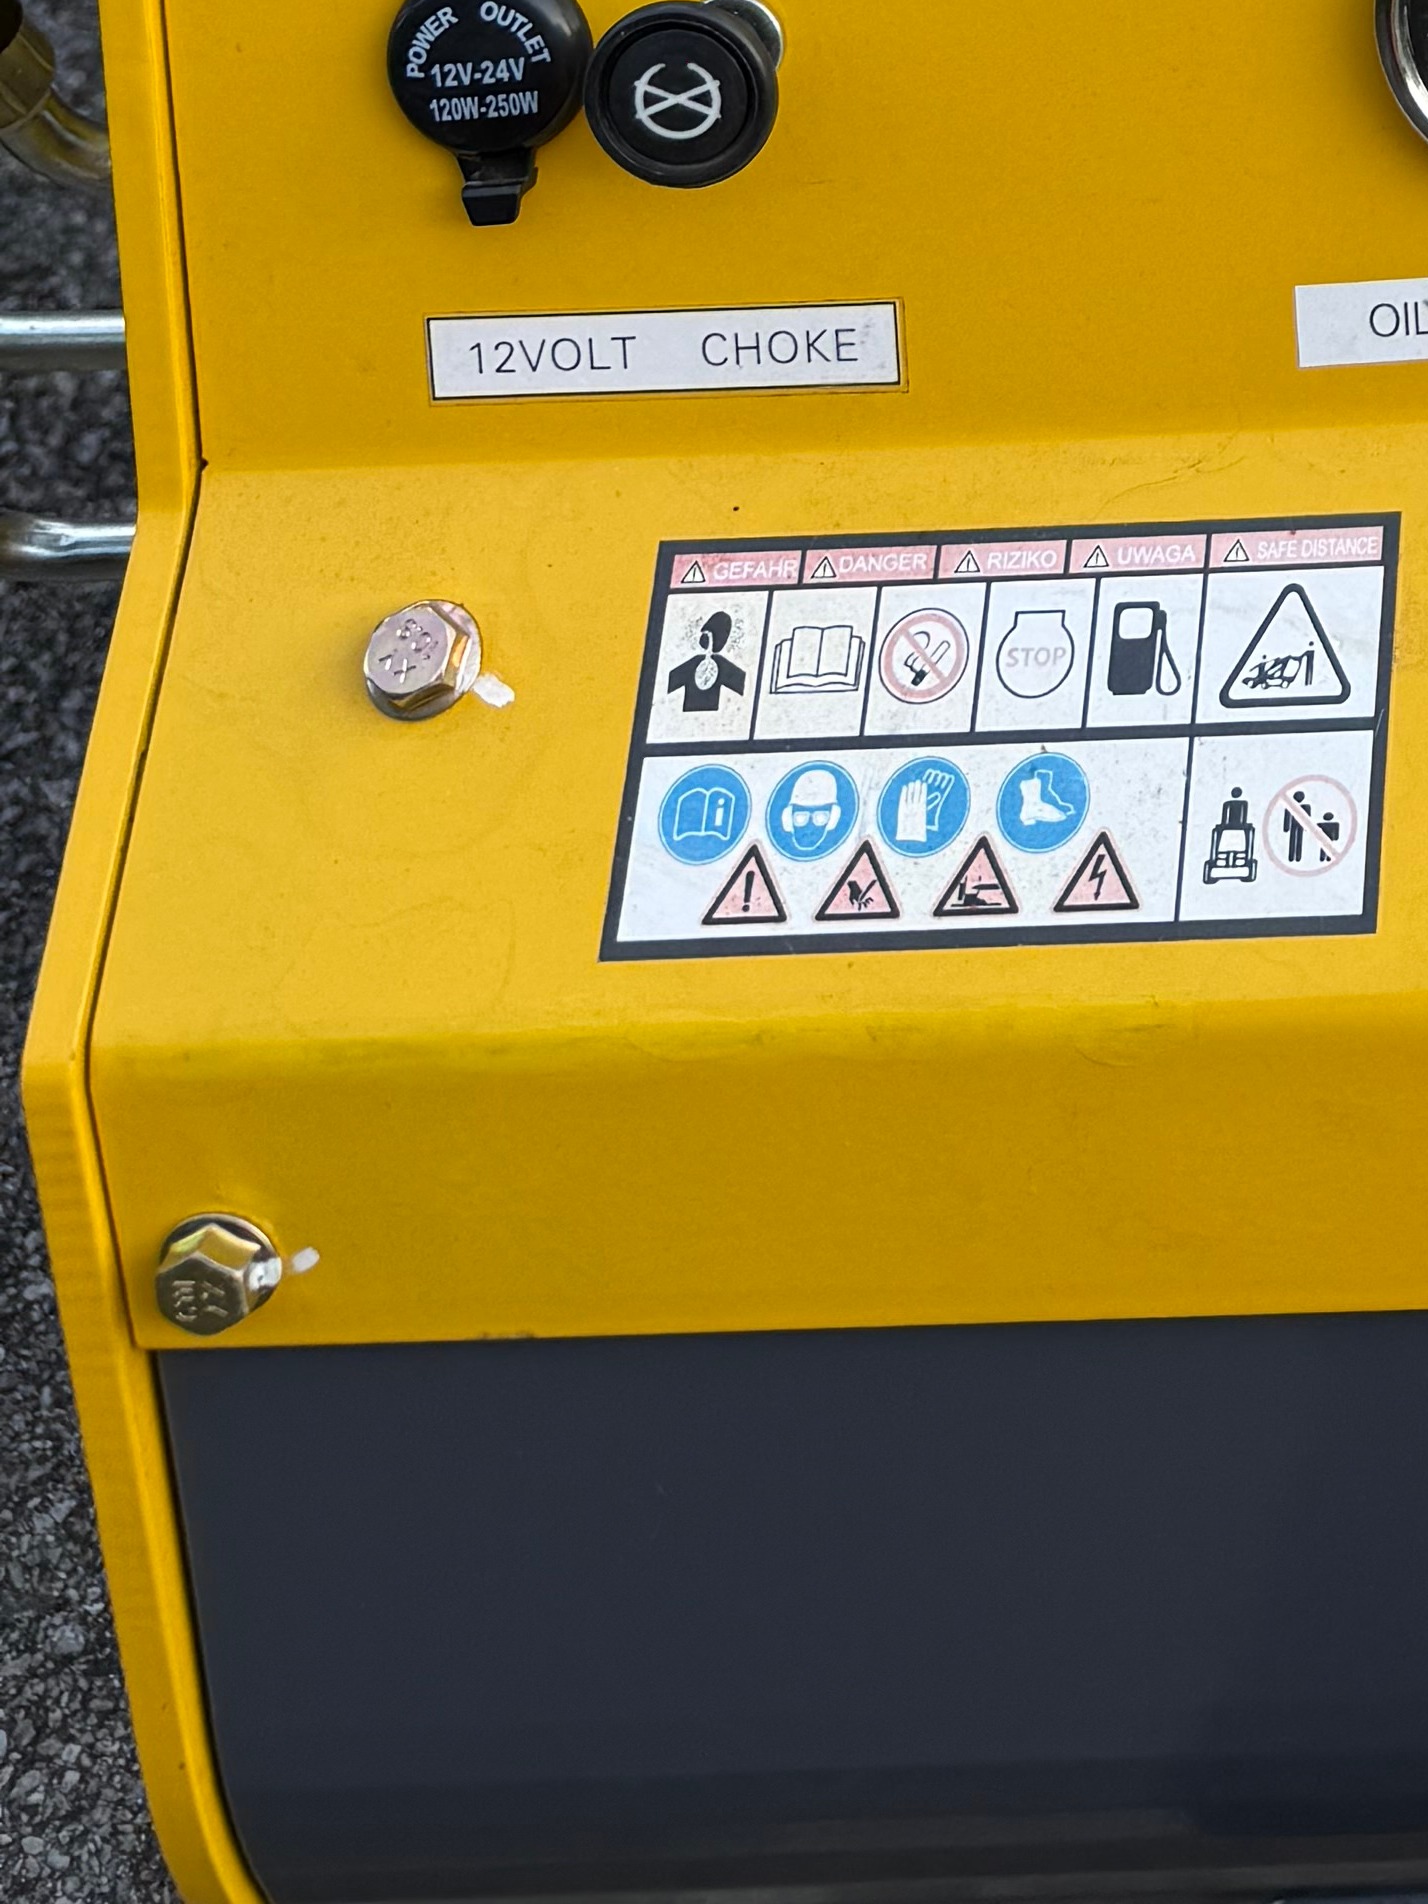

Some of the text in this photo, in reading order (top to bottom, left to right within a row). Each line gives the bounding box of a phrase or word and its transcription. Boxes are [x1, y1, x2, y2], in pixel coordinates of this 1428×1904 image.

[406, 0, 552, 80] POWER OUTLET
[430, 57, 526, 89] 12V-24V
[429, 90, 540, 123] 120W-250W
[469, 327, 860, 375] 12VOLT CHOKE
[987, 549, 1058, 571] RIZIKO
[1116, 543, 1196, 565] UWAGA
[1257, 535, 1379, 561] SAFE DISTANCE
[712, 557, 799, 581] GEFAHR
[838, 553, 928, 573] DANGER
[1005, 646, 1067, 668] STOP
